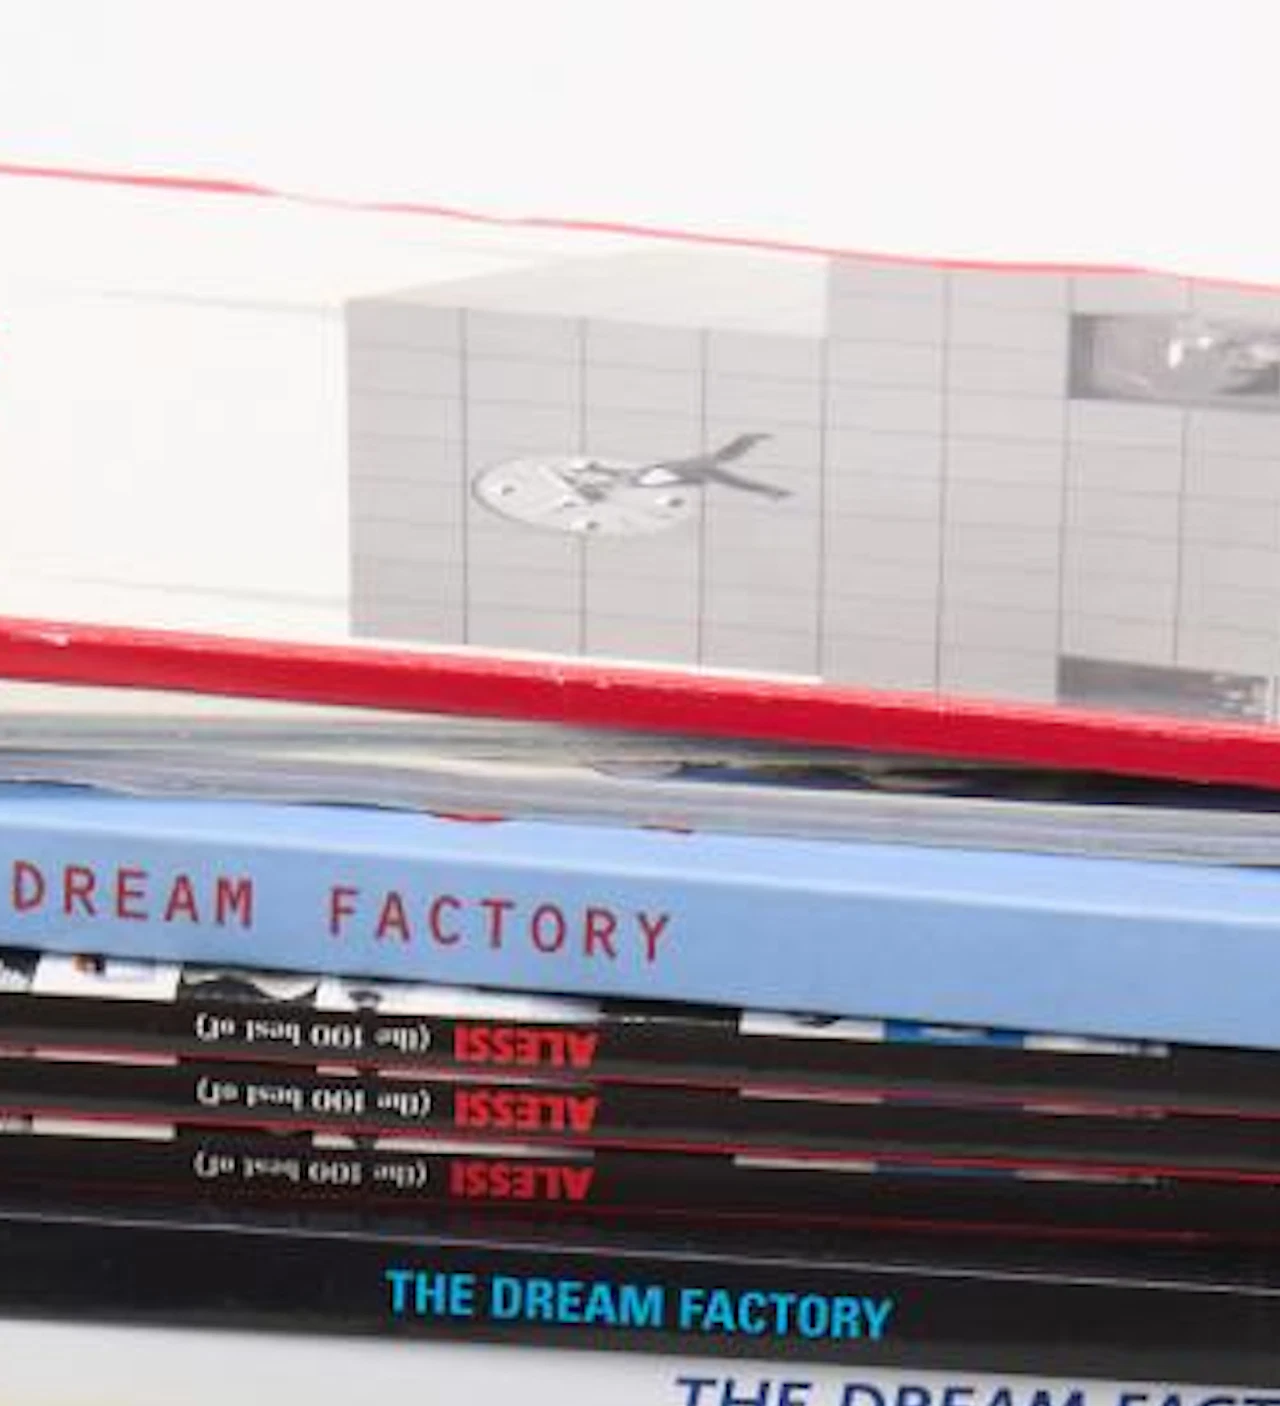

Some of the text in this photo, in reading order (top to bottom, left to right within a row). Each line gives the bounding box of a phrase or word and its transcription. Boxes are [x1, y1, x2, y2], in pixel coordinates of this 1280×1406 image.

[11, 859, 256, 929] DREAM
[329, 885, 674, 964] FACTORY
[195, 1012, 236, 1042] of)
[245, 1018, 302, 1047] best
[311, 1024, 364, 1051] 100
[454, 1025, 599, 1069] ALESSI
[195, 1075, 240, 1106] of)
[246, 1082, 303, 1112] best
[312, 1088, 366, 1116] 100
[454, 1090, 601, 1133] ALESSI
[193, 1150, 235, 1180] of)
[241, 1154, 301, 1183] best
[307, 1160, 363, 1186] 100
[450, 1161, 595, 1201] ALESSI
[384, 1268, 476, 1318] THE
[491, 1275, 663, 1329] DREAM
[679, 1287, 893, 1342] FACTORY
